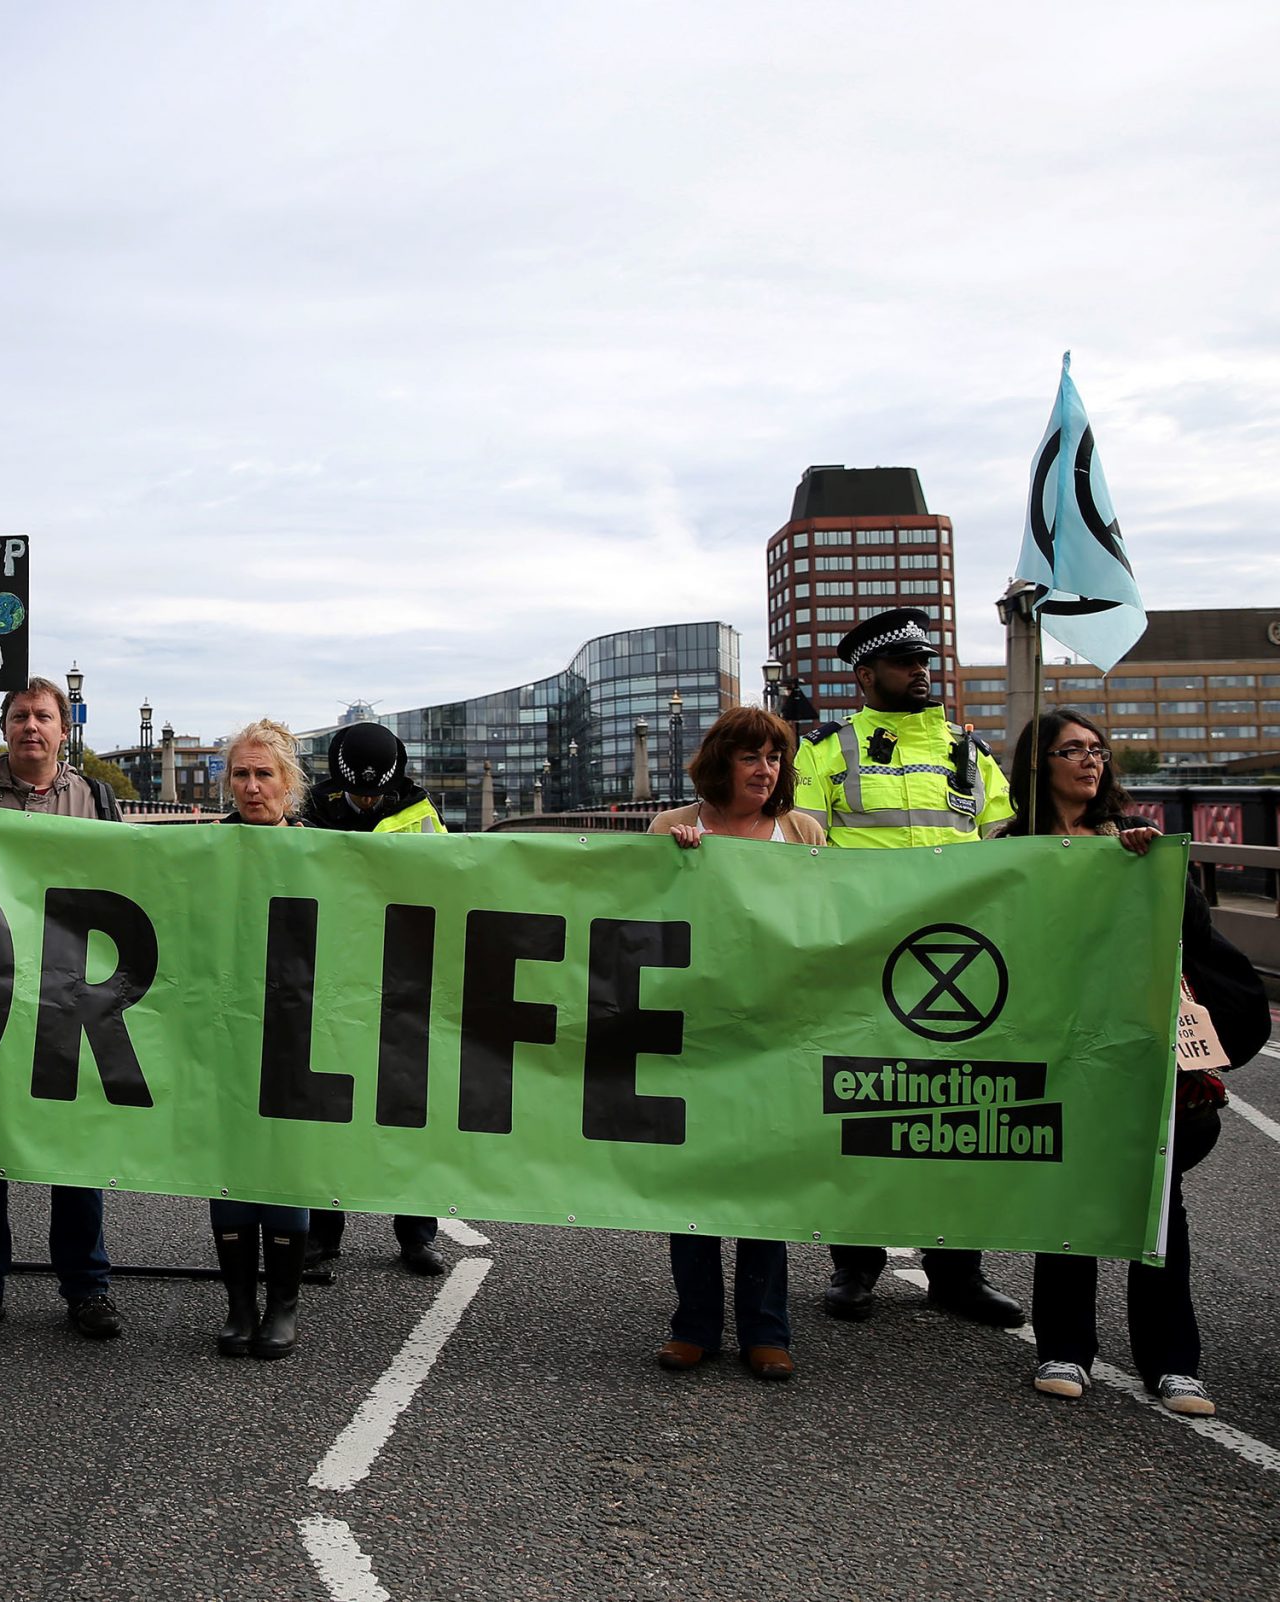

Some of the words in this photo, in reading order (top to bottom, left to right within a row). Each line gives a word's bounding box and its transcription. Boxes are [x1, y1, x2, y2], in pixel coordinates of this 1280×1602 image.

[258, 896, 692, 1146] LIFE
[1177, 1039, 1211, 1058] LIFE
[833, 1061, 1017, 1105] extinction
[891, 1108, 1054, 1155] rebellion
